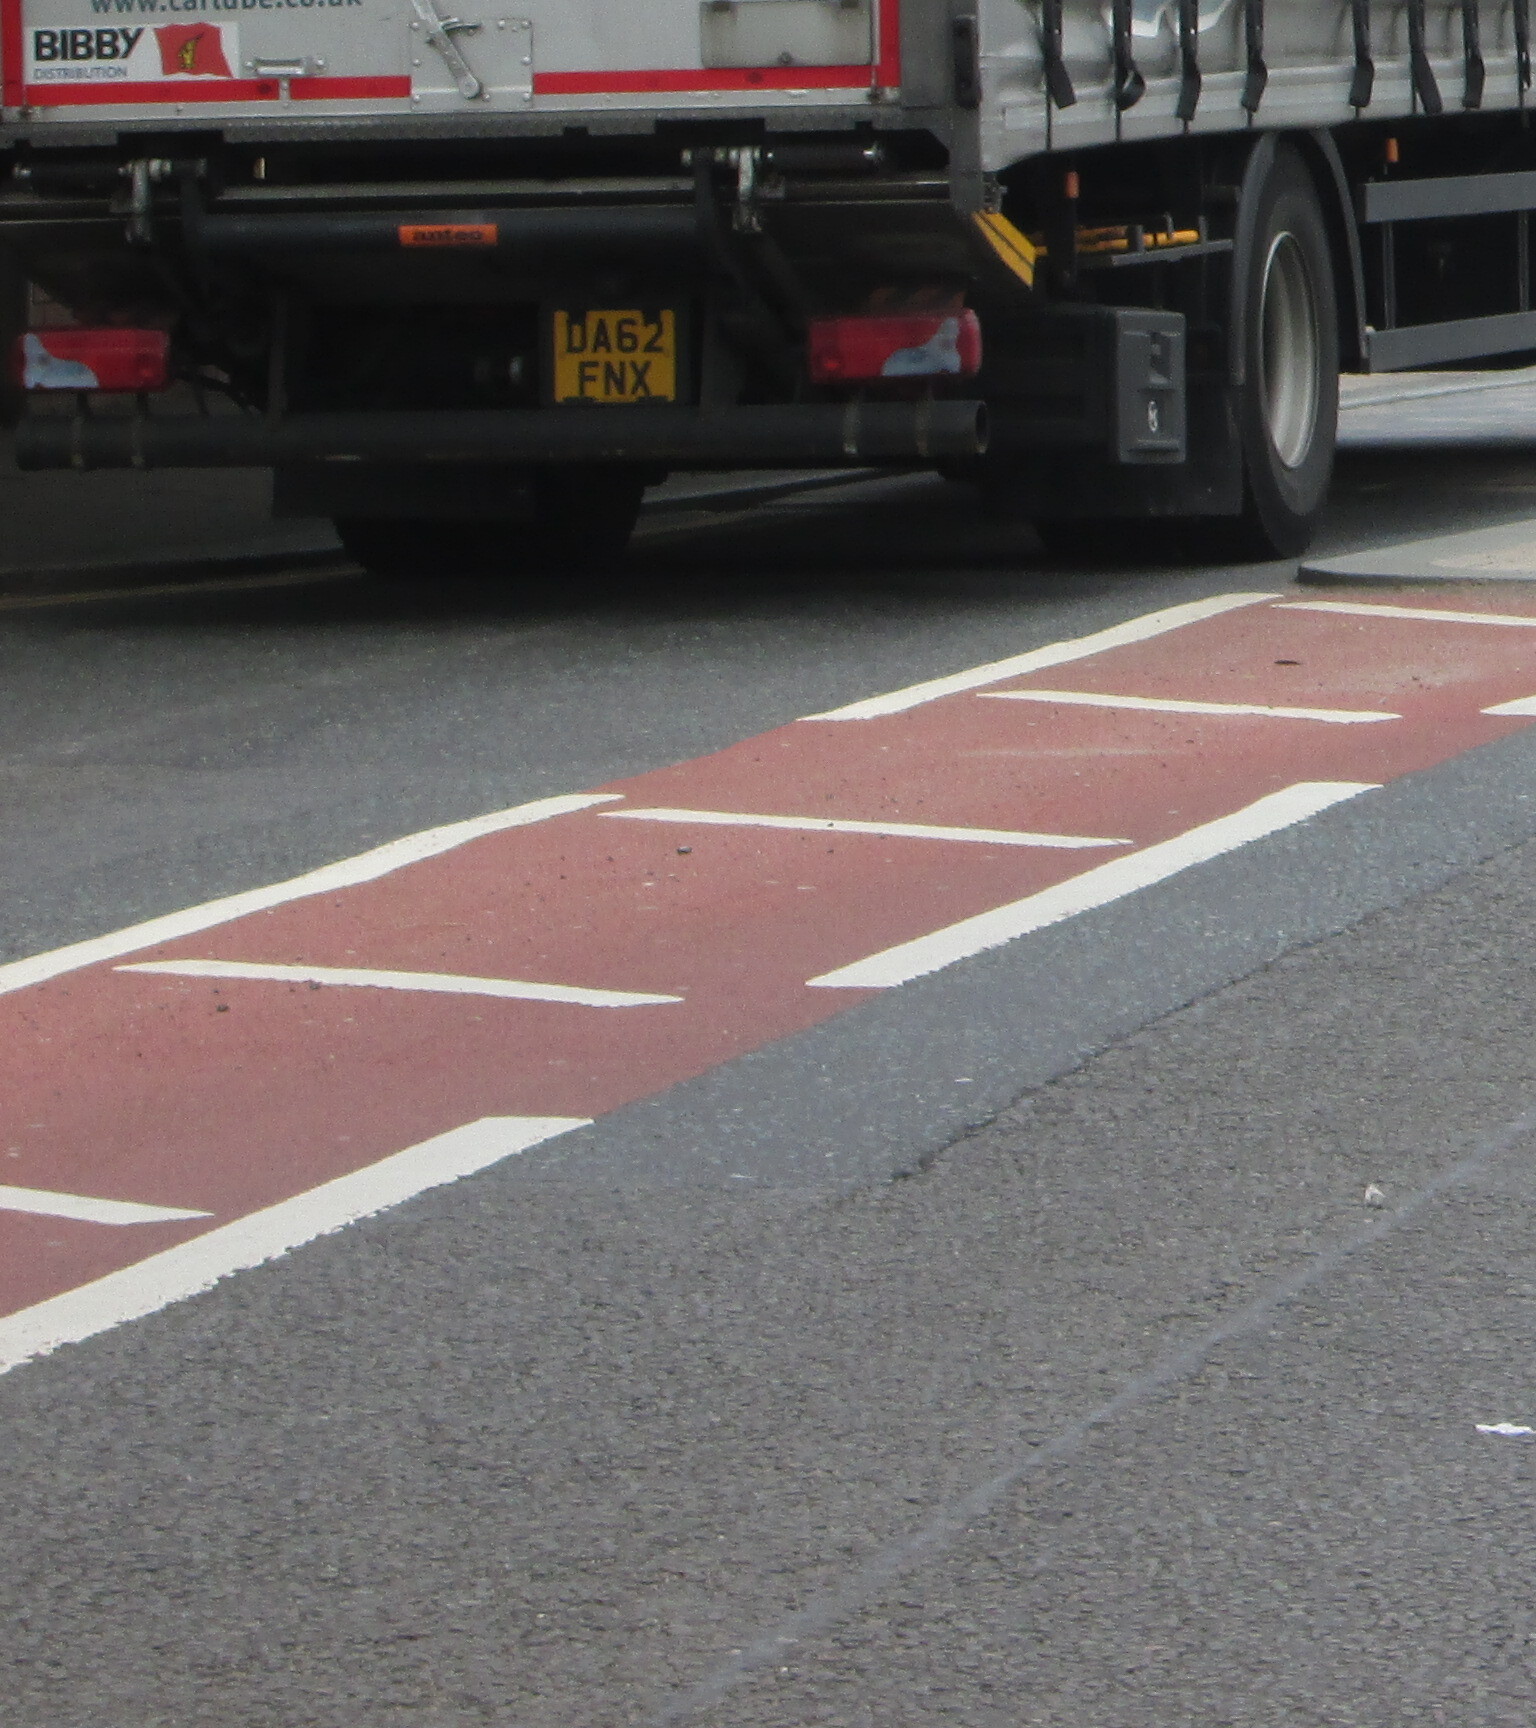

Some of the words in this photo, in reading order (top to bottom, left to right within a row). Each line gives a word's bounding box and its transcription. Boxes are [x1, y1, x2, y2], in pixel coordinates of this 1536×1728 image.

[34, 26, 145, 61] BIBBY
[33, 65, 129, 80] DISTRIBUTION
[577, 360, 653, 396] FNX
